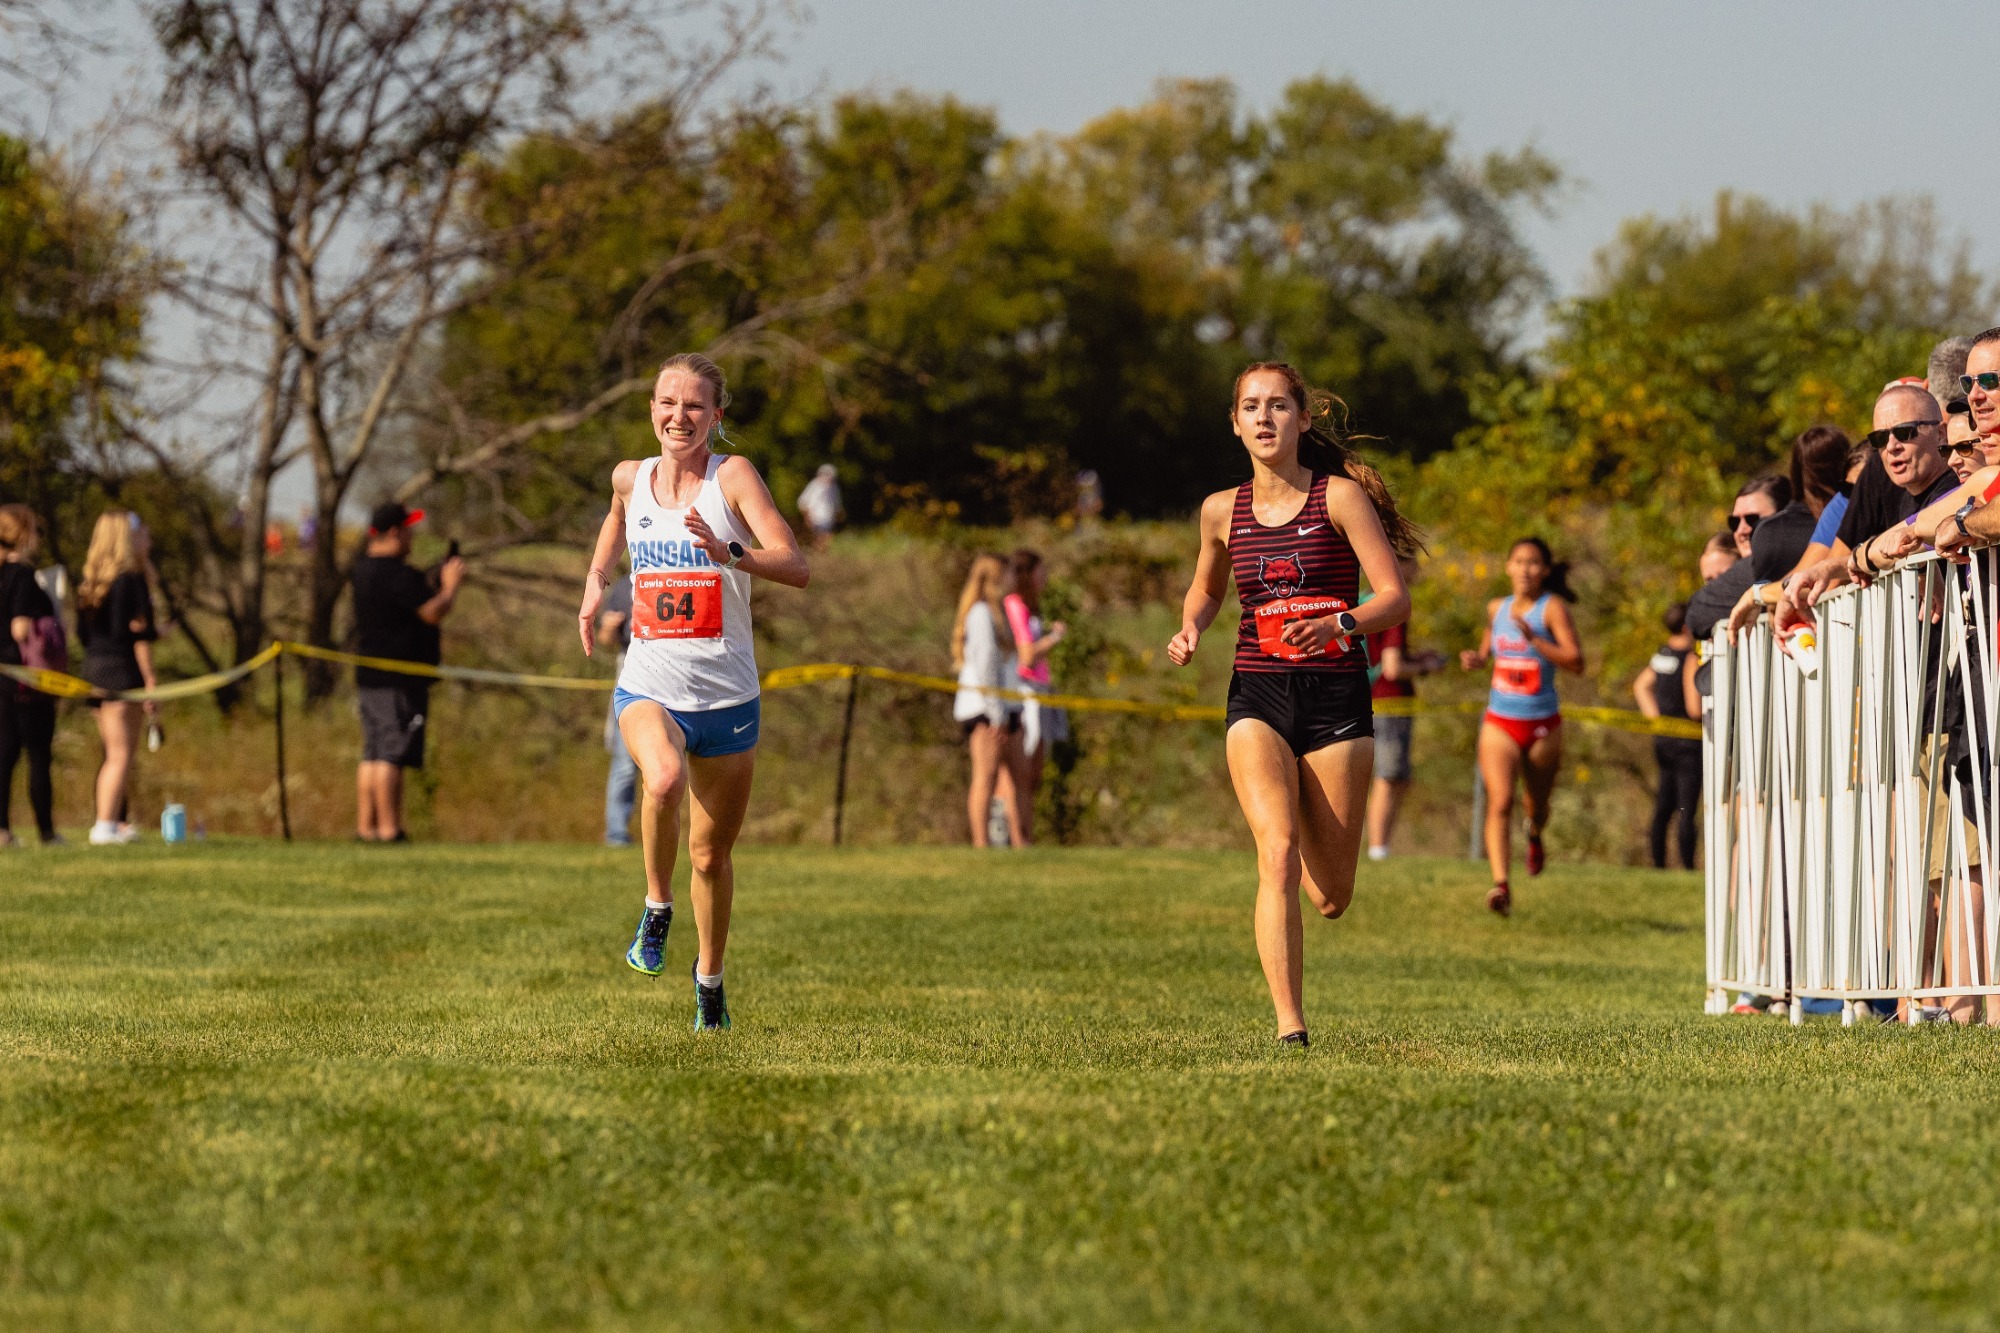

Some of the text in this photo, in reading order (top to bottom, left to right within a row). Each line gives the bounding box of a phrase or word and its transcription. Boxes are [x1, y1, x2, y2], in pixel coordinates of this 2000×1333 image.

[629, 539, 722, 570] COUGAR
[639, 578, 716, 589] Lewis Crossover
[656, 592, 695, 621] 64
[1259, 600, 1341, 617] Lewis Crossover
